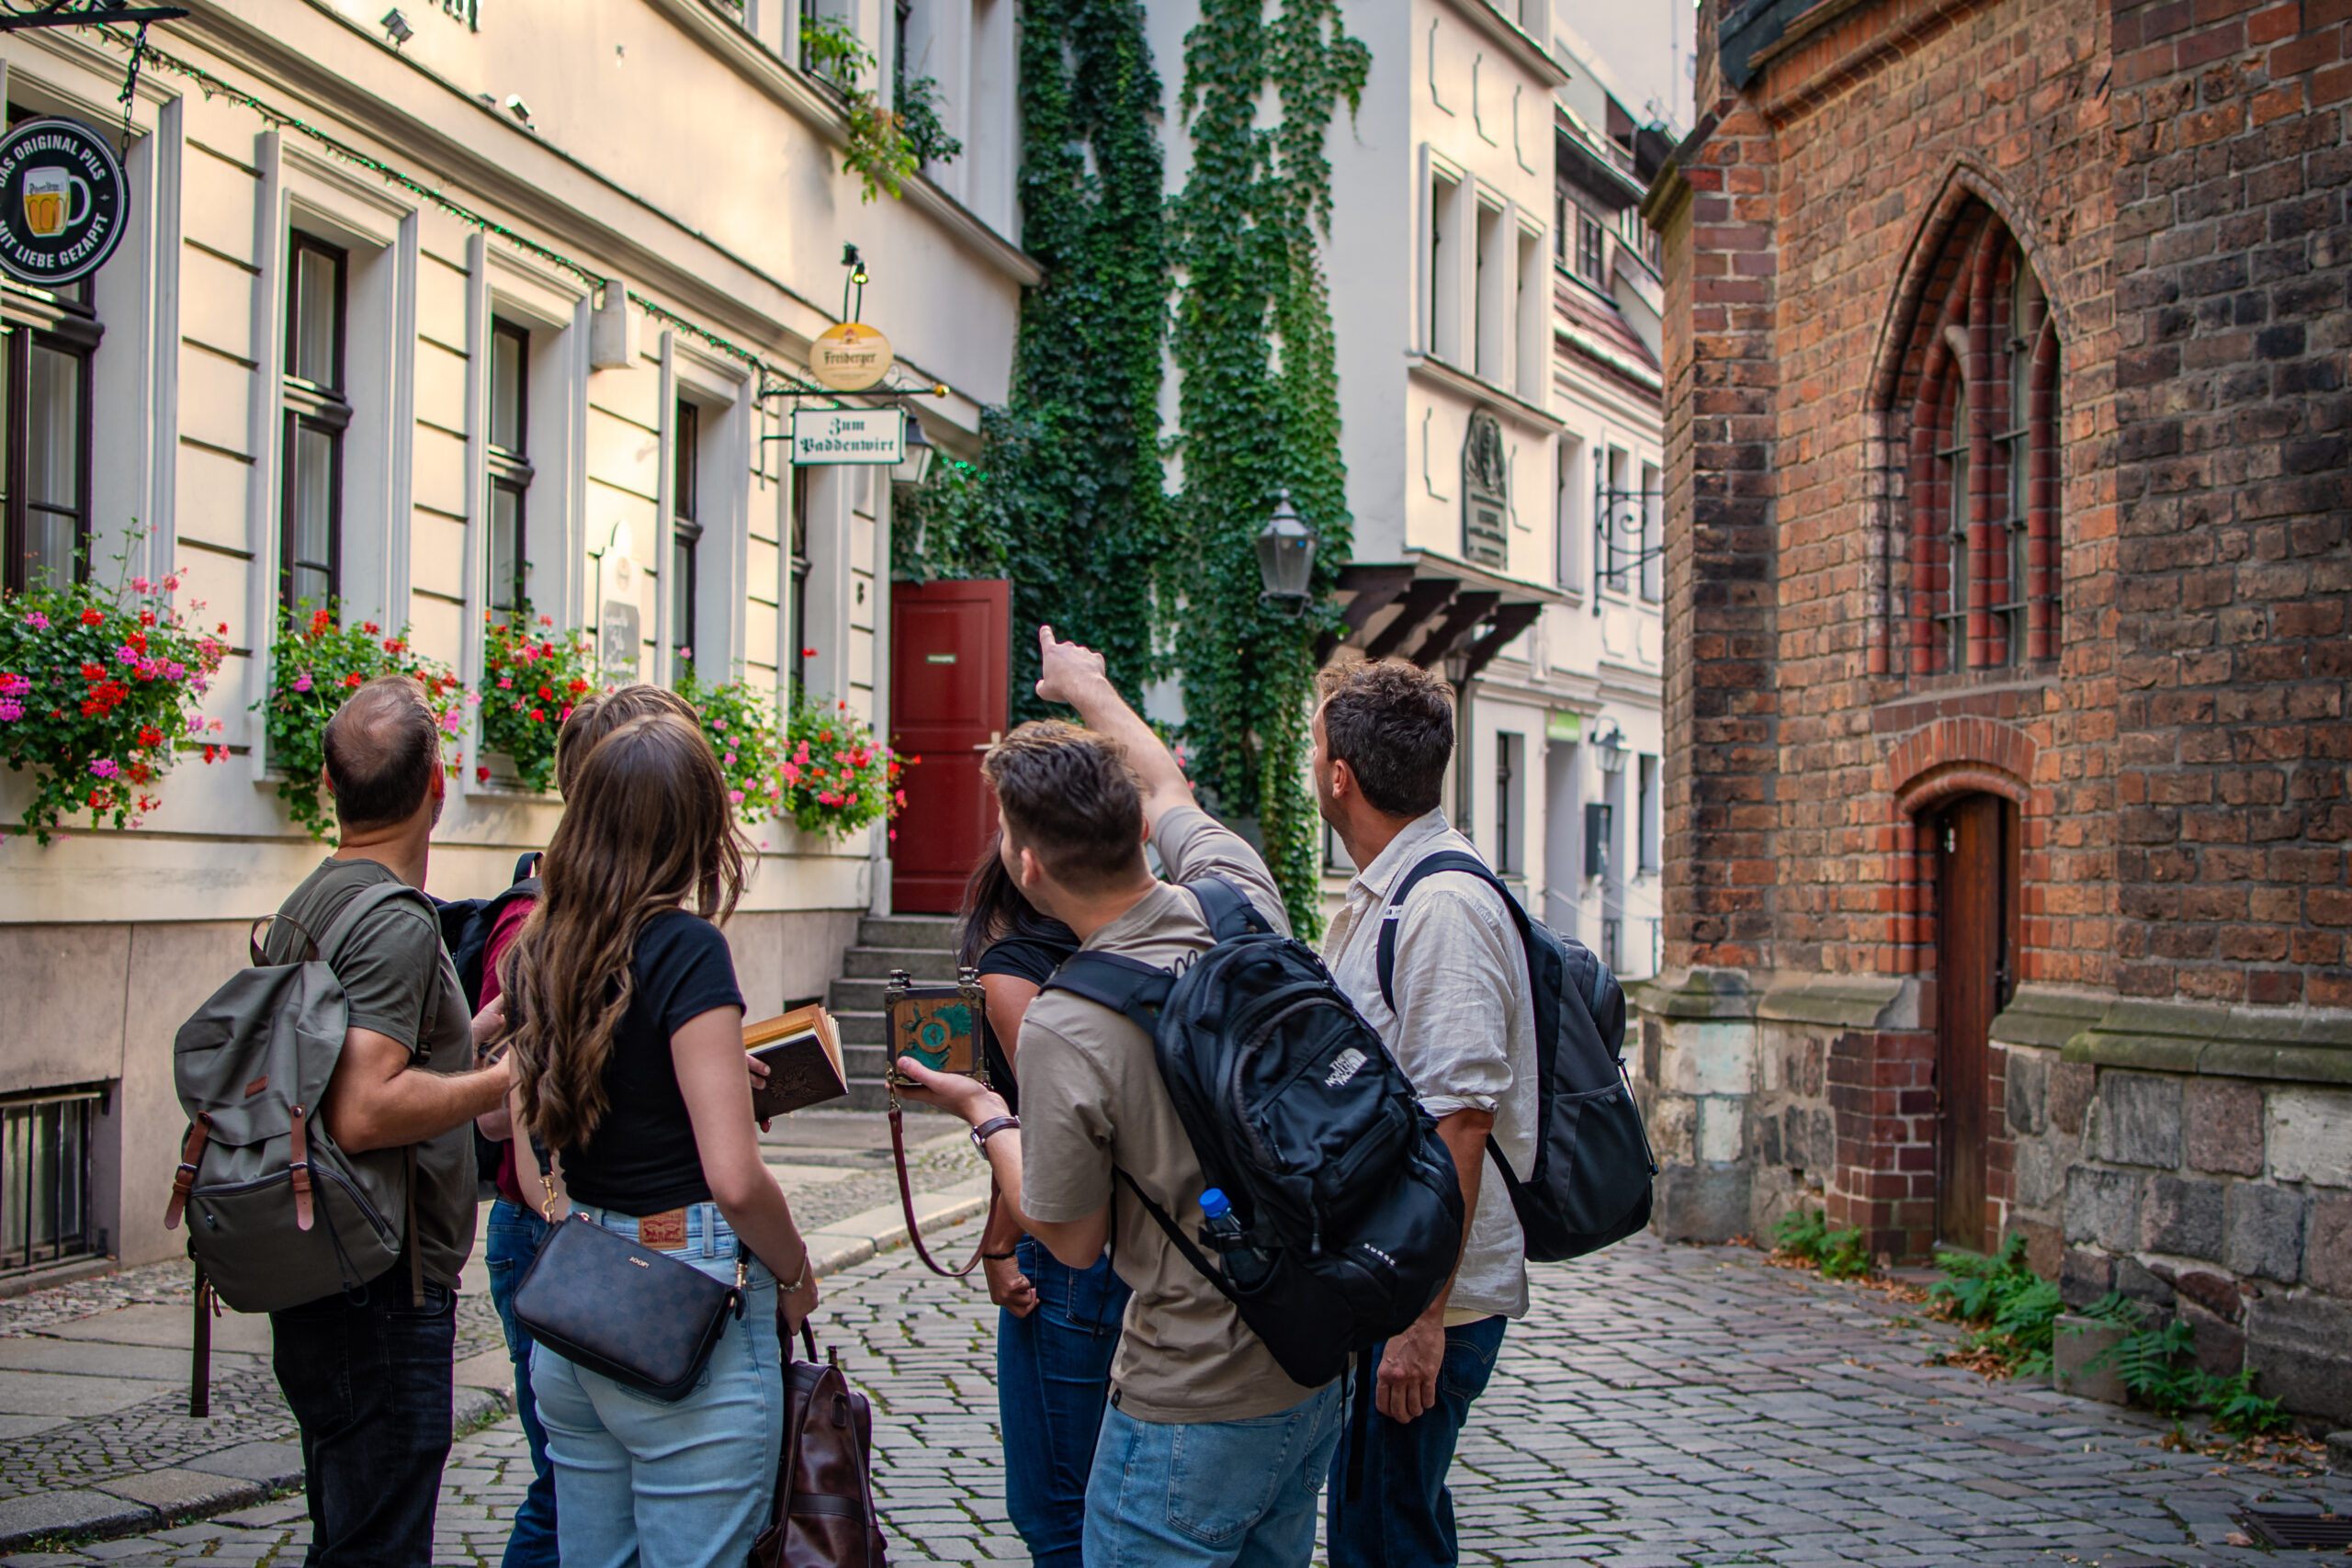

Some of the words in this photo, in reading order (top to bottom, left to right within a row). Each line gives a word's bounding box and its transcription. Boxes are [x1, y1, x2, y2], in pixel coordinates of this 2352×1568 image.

[13, 135, 78, 161] ORIGINAL
[79, 148, 107, 181] PILS
[15, 244, 55, 268] LIEBE
[59, 212, 108, 266] GEZAPFT
[829, 418, 865, 435] Zum
[799, 437, 895, 455] Paddenwirt
[1329, 1053, 1345, 1069] THE
[1324, 1060, 1351, 1087] NORTH
[1337, 1065, 1356, 1085] FACE
